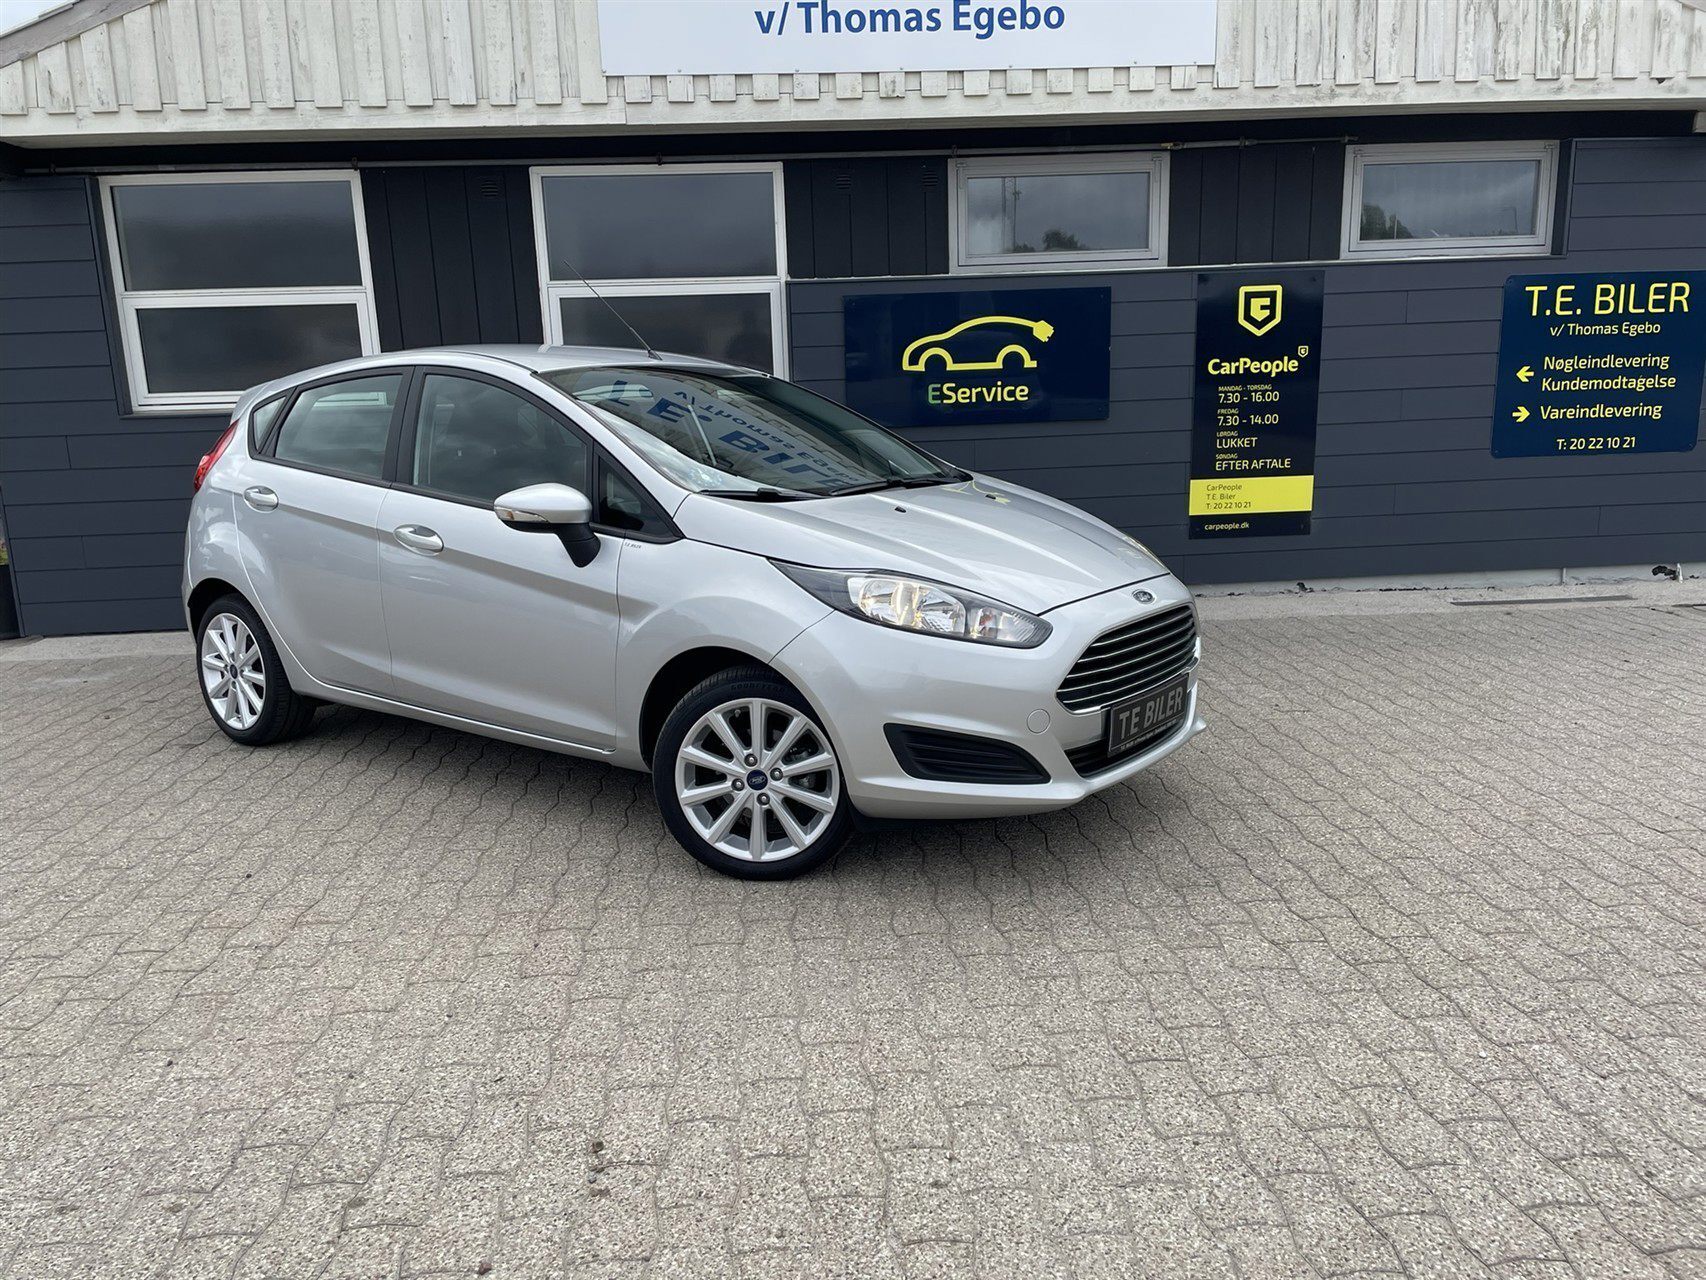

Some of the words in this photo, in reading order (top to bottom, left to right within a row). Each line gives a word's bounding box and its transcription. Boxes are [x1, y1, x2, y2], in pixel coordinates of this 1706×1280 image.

[754, 2, 790, 35] v/
[796, 0, 942, 34] Thomas
[953, 0, 1065, 40] Egebo
[1525, 284, 1582, 316] T.E.
[1594, 282, 1691, 315] BILER
[1550, 323, 1565, 337] v/
[1568, 322, 1619, 336] Thomas
[1622, 321, 1661, 336] Egebo
[1207, 356, 1299, 378] CarPeople
[1543, 353, 1670, 373] Nøgleindlevering
[1541, 374, 1677, 392] Kundemodtagelse
[928, 381, 1029, 405] EService
[1218, 393, 1241, 404] 7.30
[1251, 391, 1280, 402] 16.00
[1217, 415, 1240, 426] 7.30
[1249, 413, 1279, 425] 14.00
[1540, 403, 1663, 420] Vareindlevering
[1216, 437, 1258, 449] LUKKET
[1556, 438, 1567, 450] T:
[1569, 438, 1586, 450] 20
[1588, 437, 1604, 449] 22
[1606, 437, 1620, 449] 10
[1622, 436, 1636, 448] 21
[1215, 459, 1249, 471] EFTER
[1251, 458, 1292, 469] AFTALE
[1206, 483, 1243, 491] CarPeople
[1204, 522, 1250, 531] carpeople.dk
[1143, 686, 1184, 729] BILER
